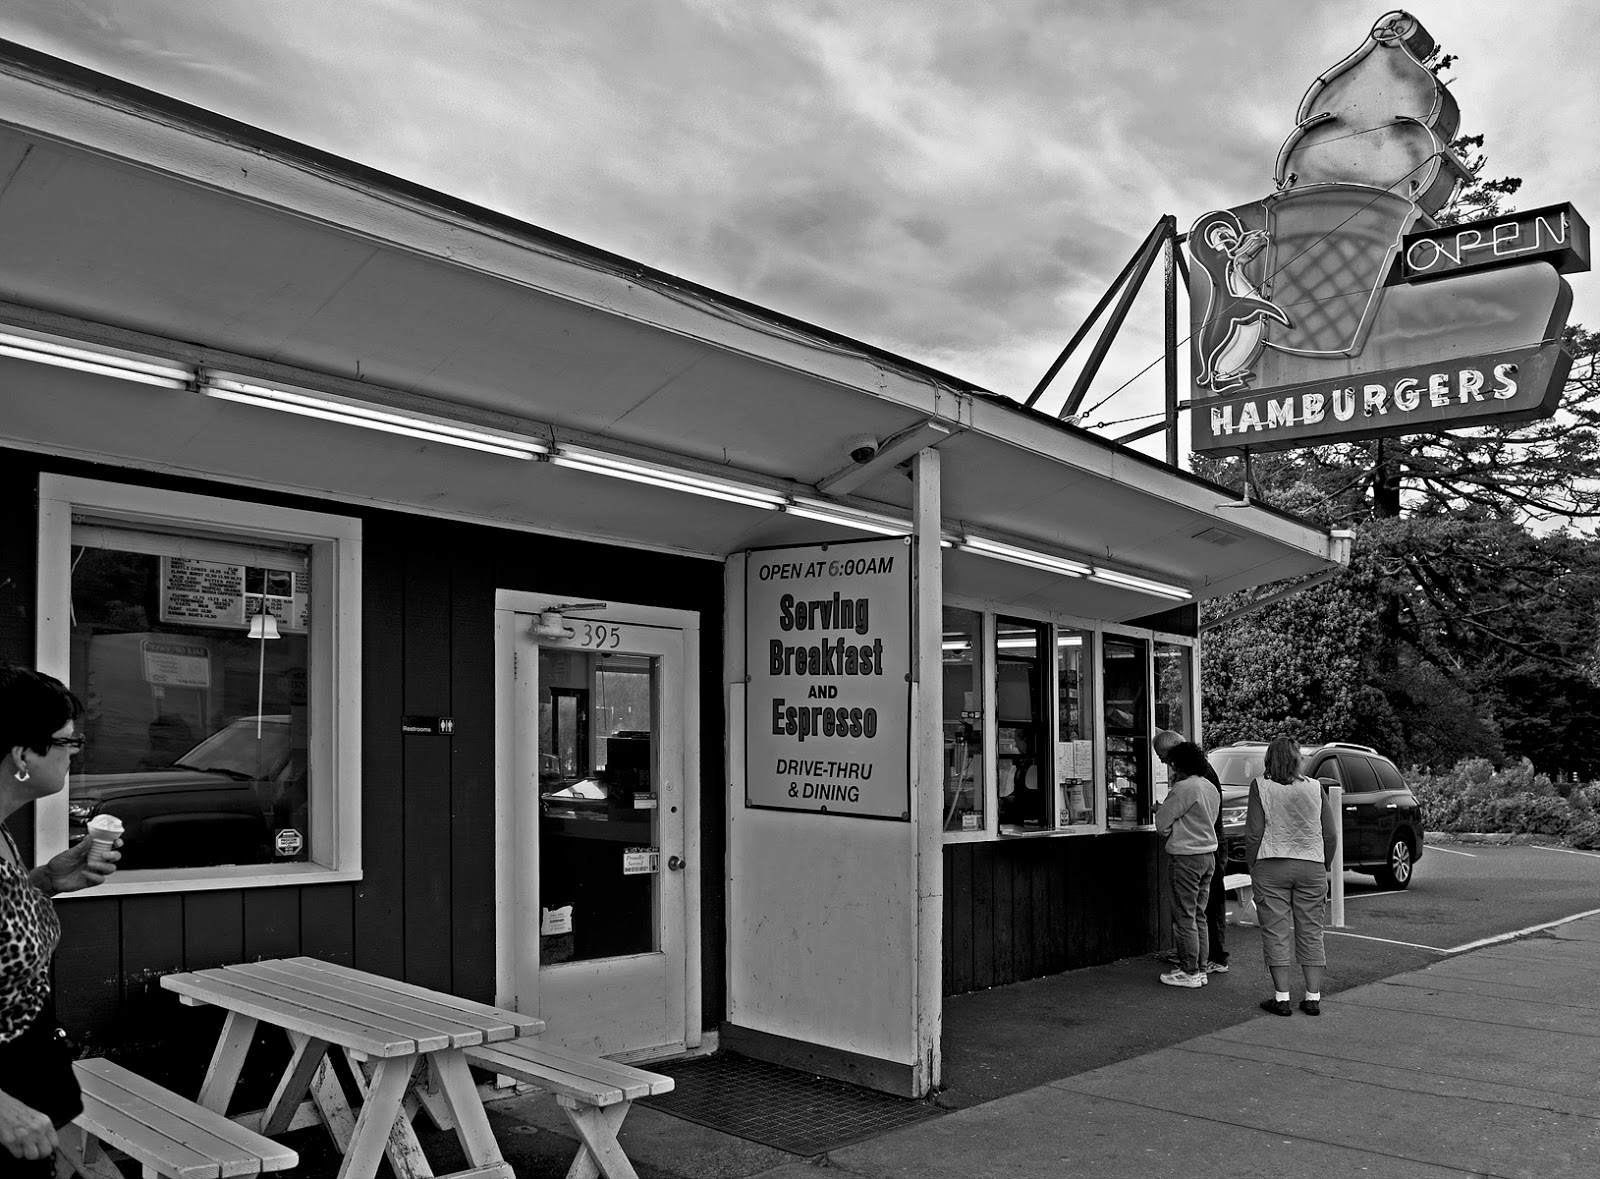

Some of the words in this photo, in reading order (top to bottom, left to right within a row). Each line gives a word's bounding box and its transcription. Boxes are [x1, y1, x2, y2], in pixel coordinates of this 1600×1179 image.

[1407, 212, 1567, 271] OPEN
[1211, 363, 1519, 436] HAMBURGERS
[759, 563, 802, 581] OPEN
[805, 561, 826, 578] AT
[828, 556, 894, 577] 6:00AM
[780, 592, 869, 635] Serving
[581, 624, 621, 649] 395
[769, 637, 883, 676] Breakfast
[808, 685, 838, 699] AND
[772, 698, 877, 742] Espresso
[776, 759, 873, 780] DRIVE-THRU
[788, 782, 799, 798] &
[802, 783, 860, 802] DINING
